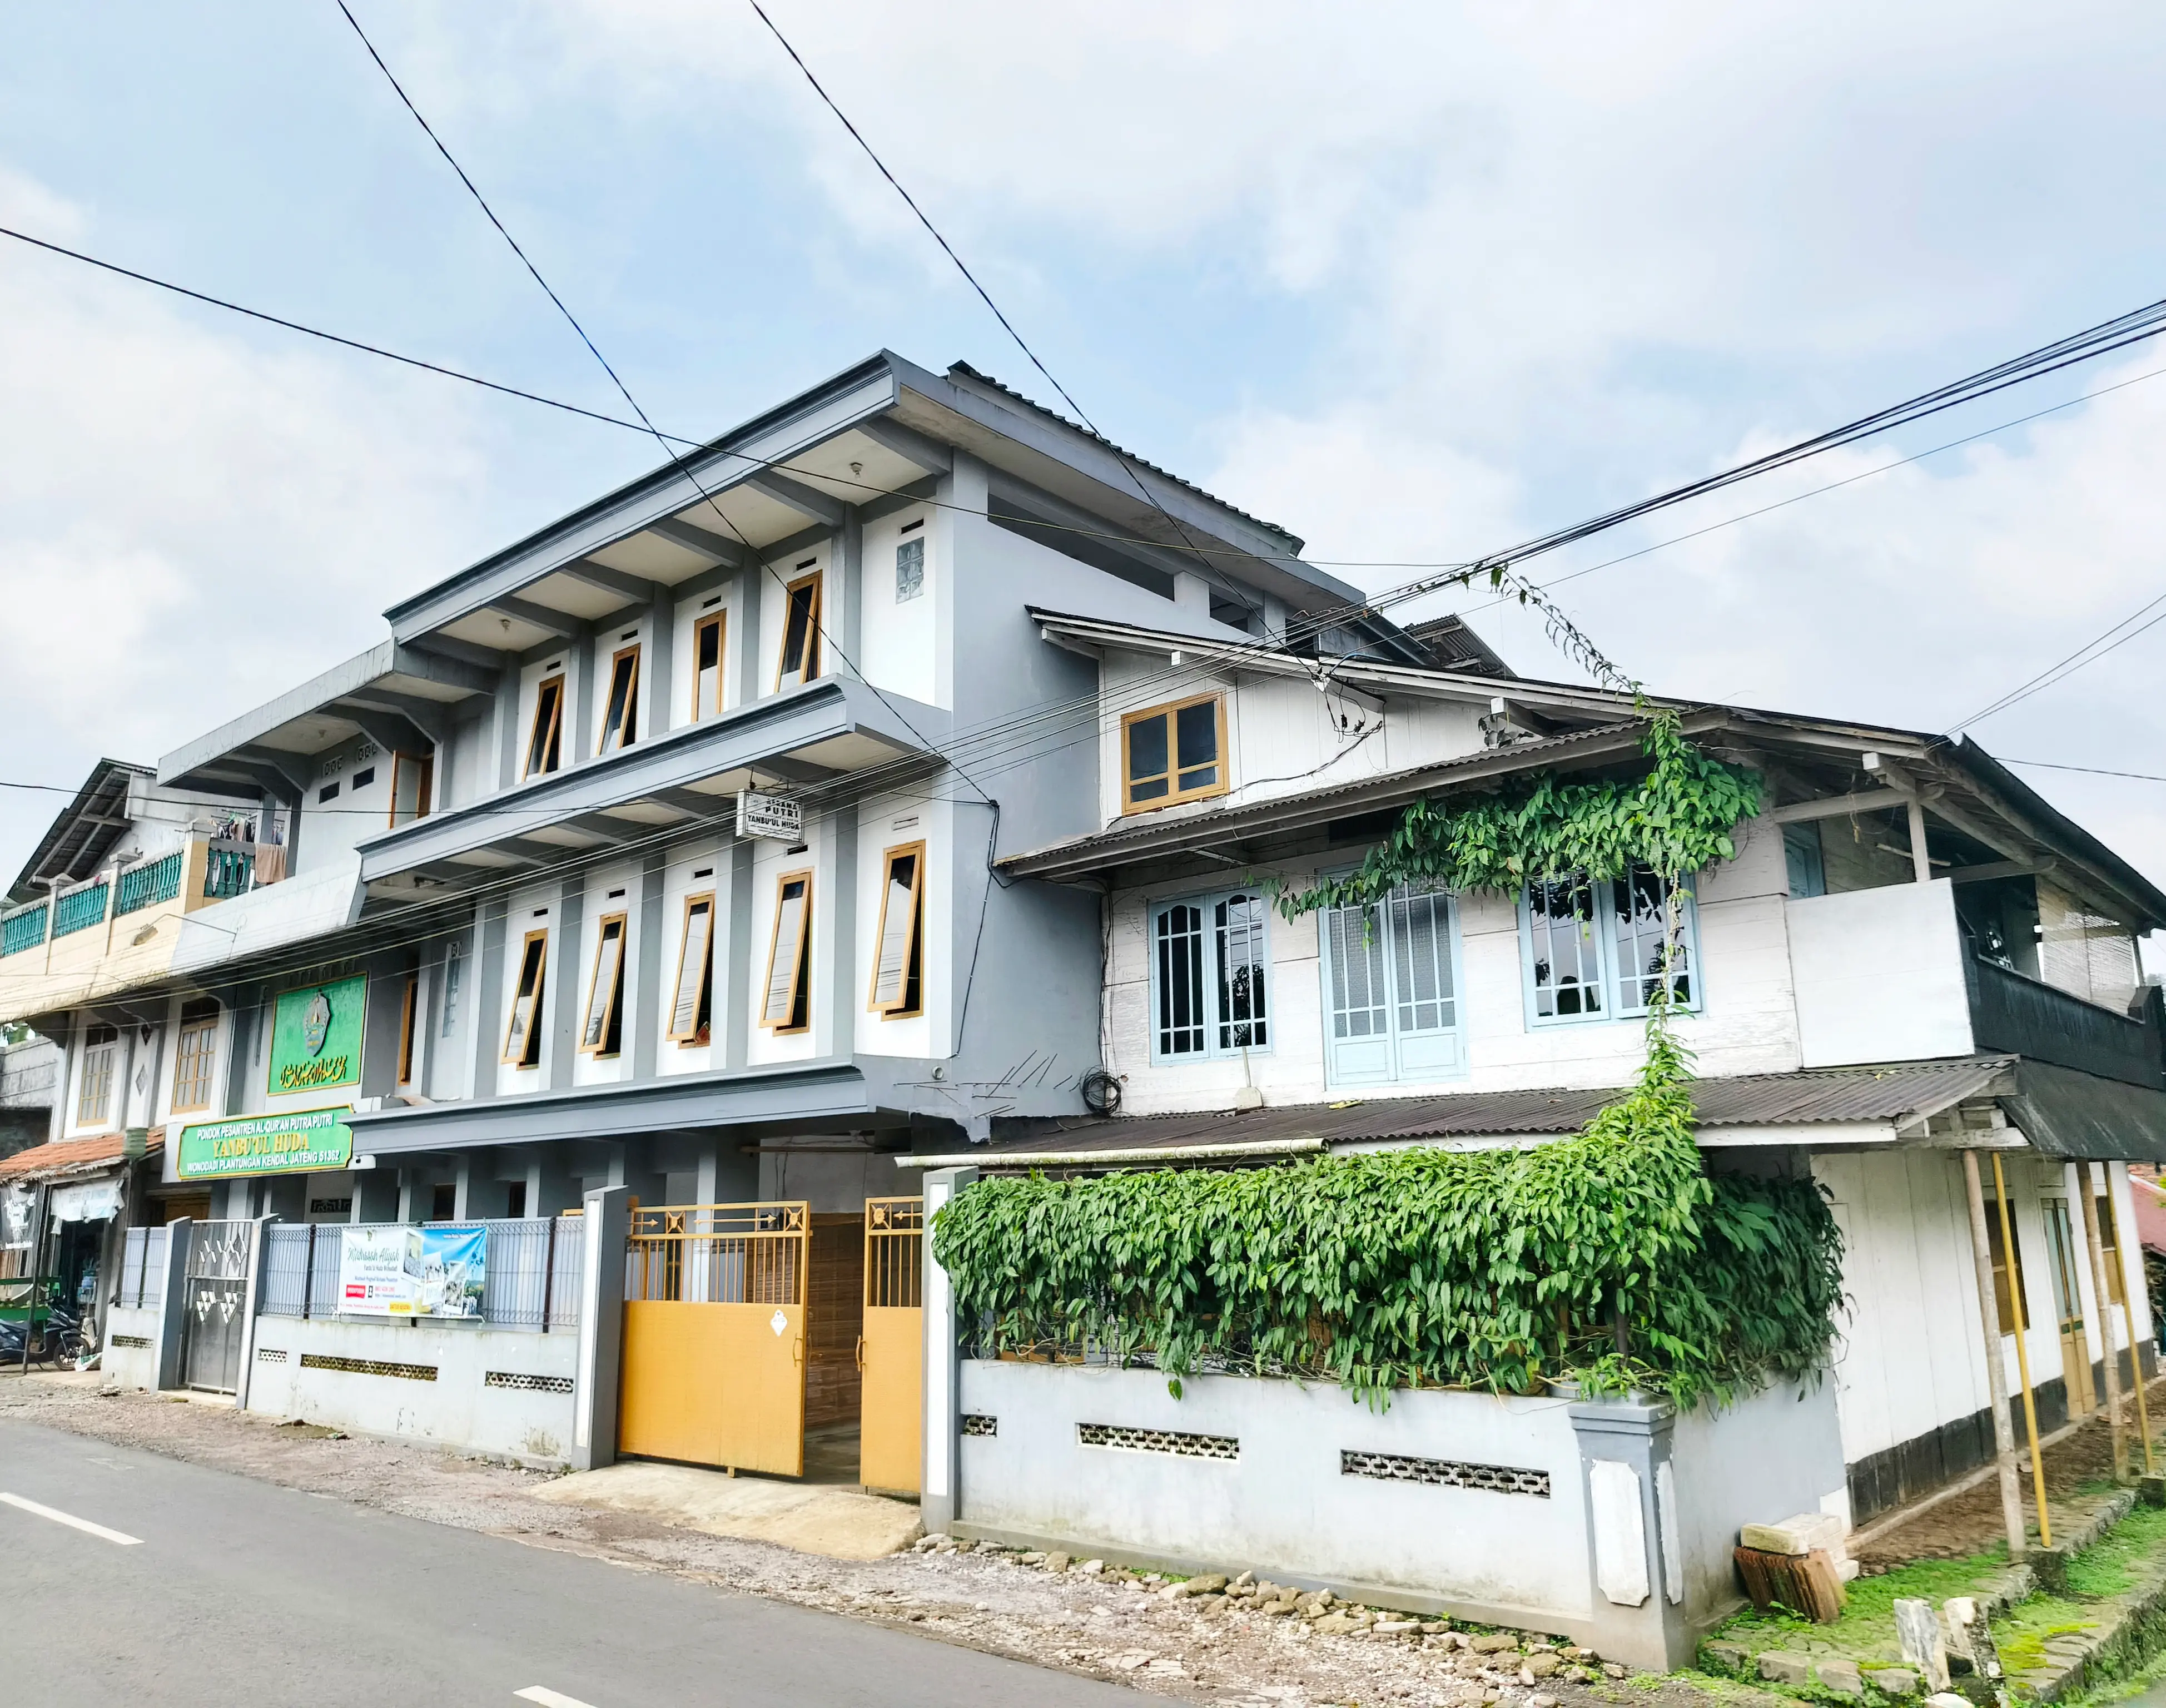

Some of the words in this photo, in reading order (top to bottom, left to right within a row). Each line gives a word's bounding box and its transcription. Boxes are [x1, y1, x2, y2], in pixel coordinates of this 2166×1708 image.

[766, 806, 798, 818] PUTRI
[197, 1125, 222, 1141] PONDOK
[222, 1121, 256, 1138] PESANTREN
[274, 1133, 310, 1153] HUDA
[187, 1159, 220, 1174] WONODADI
[219, 1156, 262, 1170] PLANTUNGAN
[261, 1153, 289, 1167] KENDAL
[290, 1151, 319, 1165] JATENG
